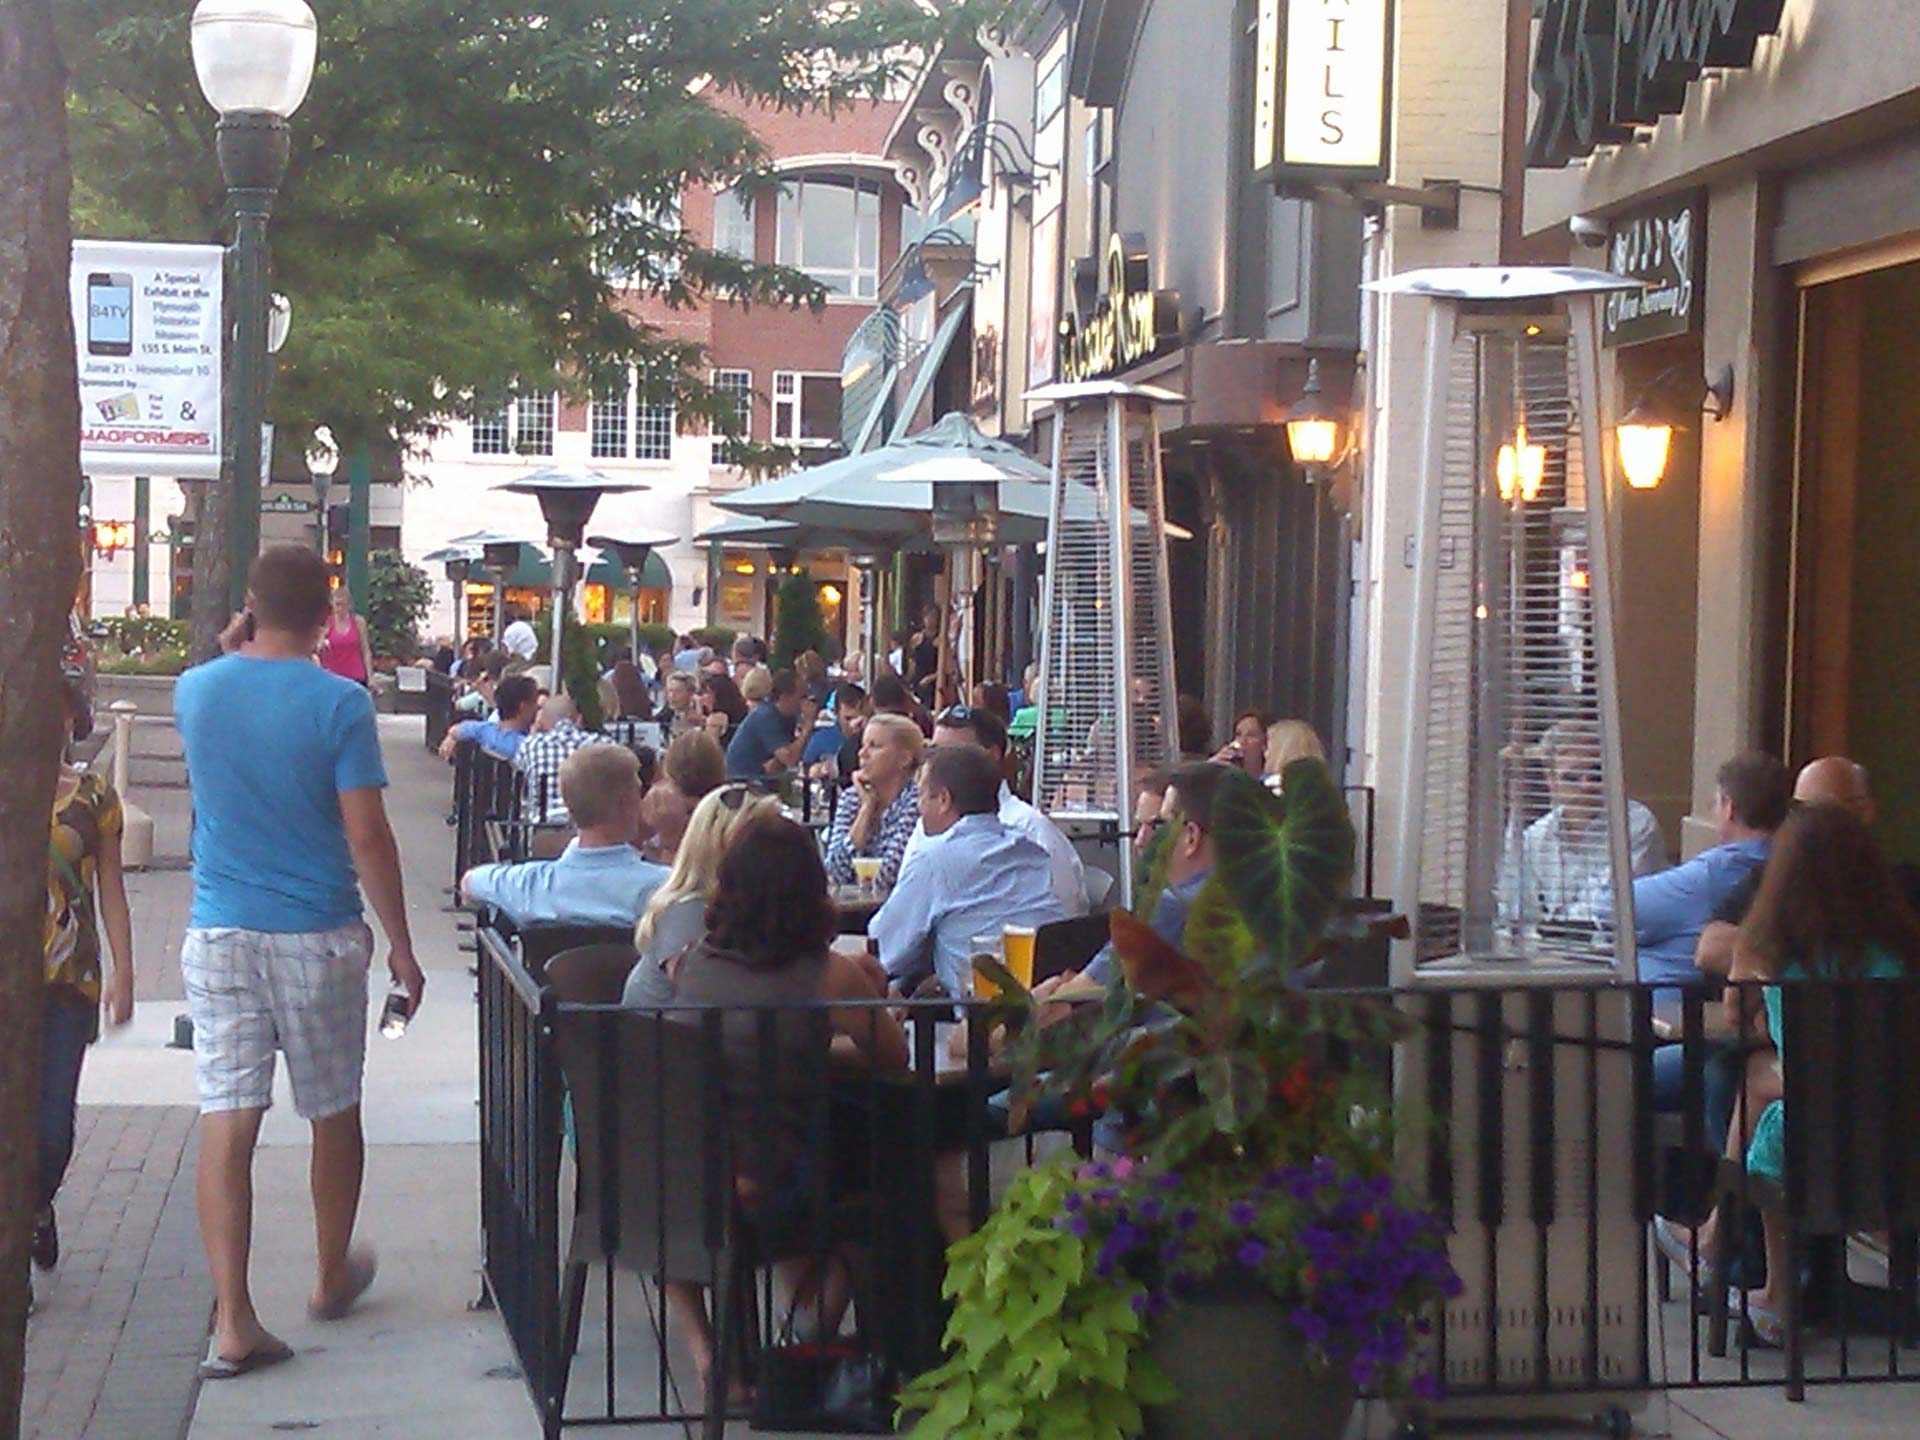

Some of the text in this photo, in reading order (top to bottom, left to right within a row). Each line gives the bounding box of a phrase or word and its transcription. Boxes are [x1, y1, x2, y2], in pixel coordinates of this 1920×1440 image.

[1320, 0, 1349, 145] ILS
[164, 273, 200, 285] Special
[144, 287, 178, 297] Exhibit
[193, 287, 210, 298] the
[173, 344, 198, 354] Main
[84, 363, 110, 374] June
[136, 364, 194, 376] November
[180, 401, 197, 422] &
